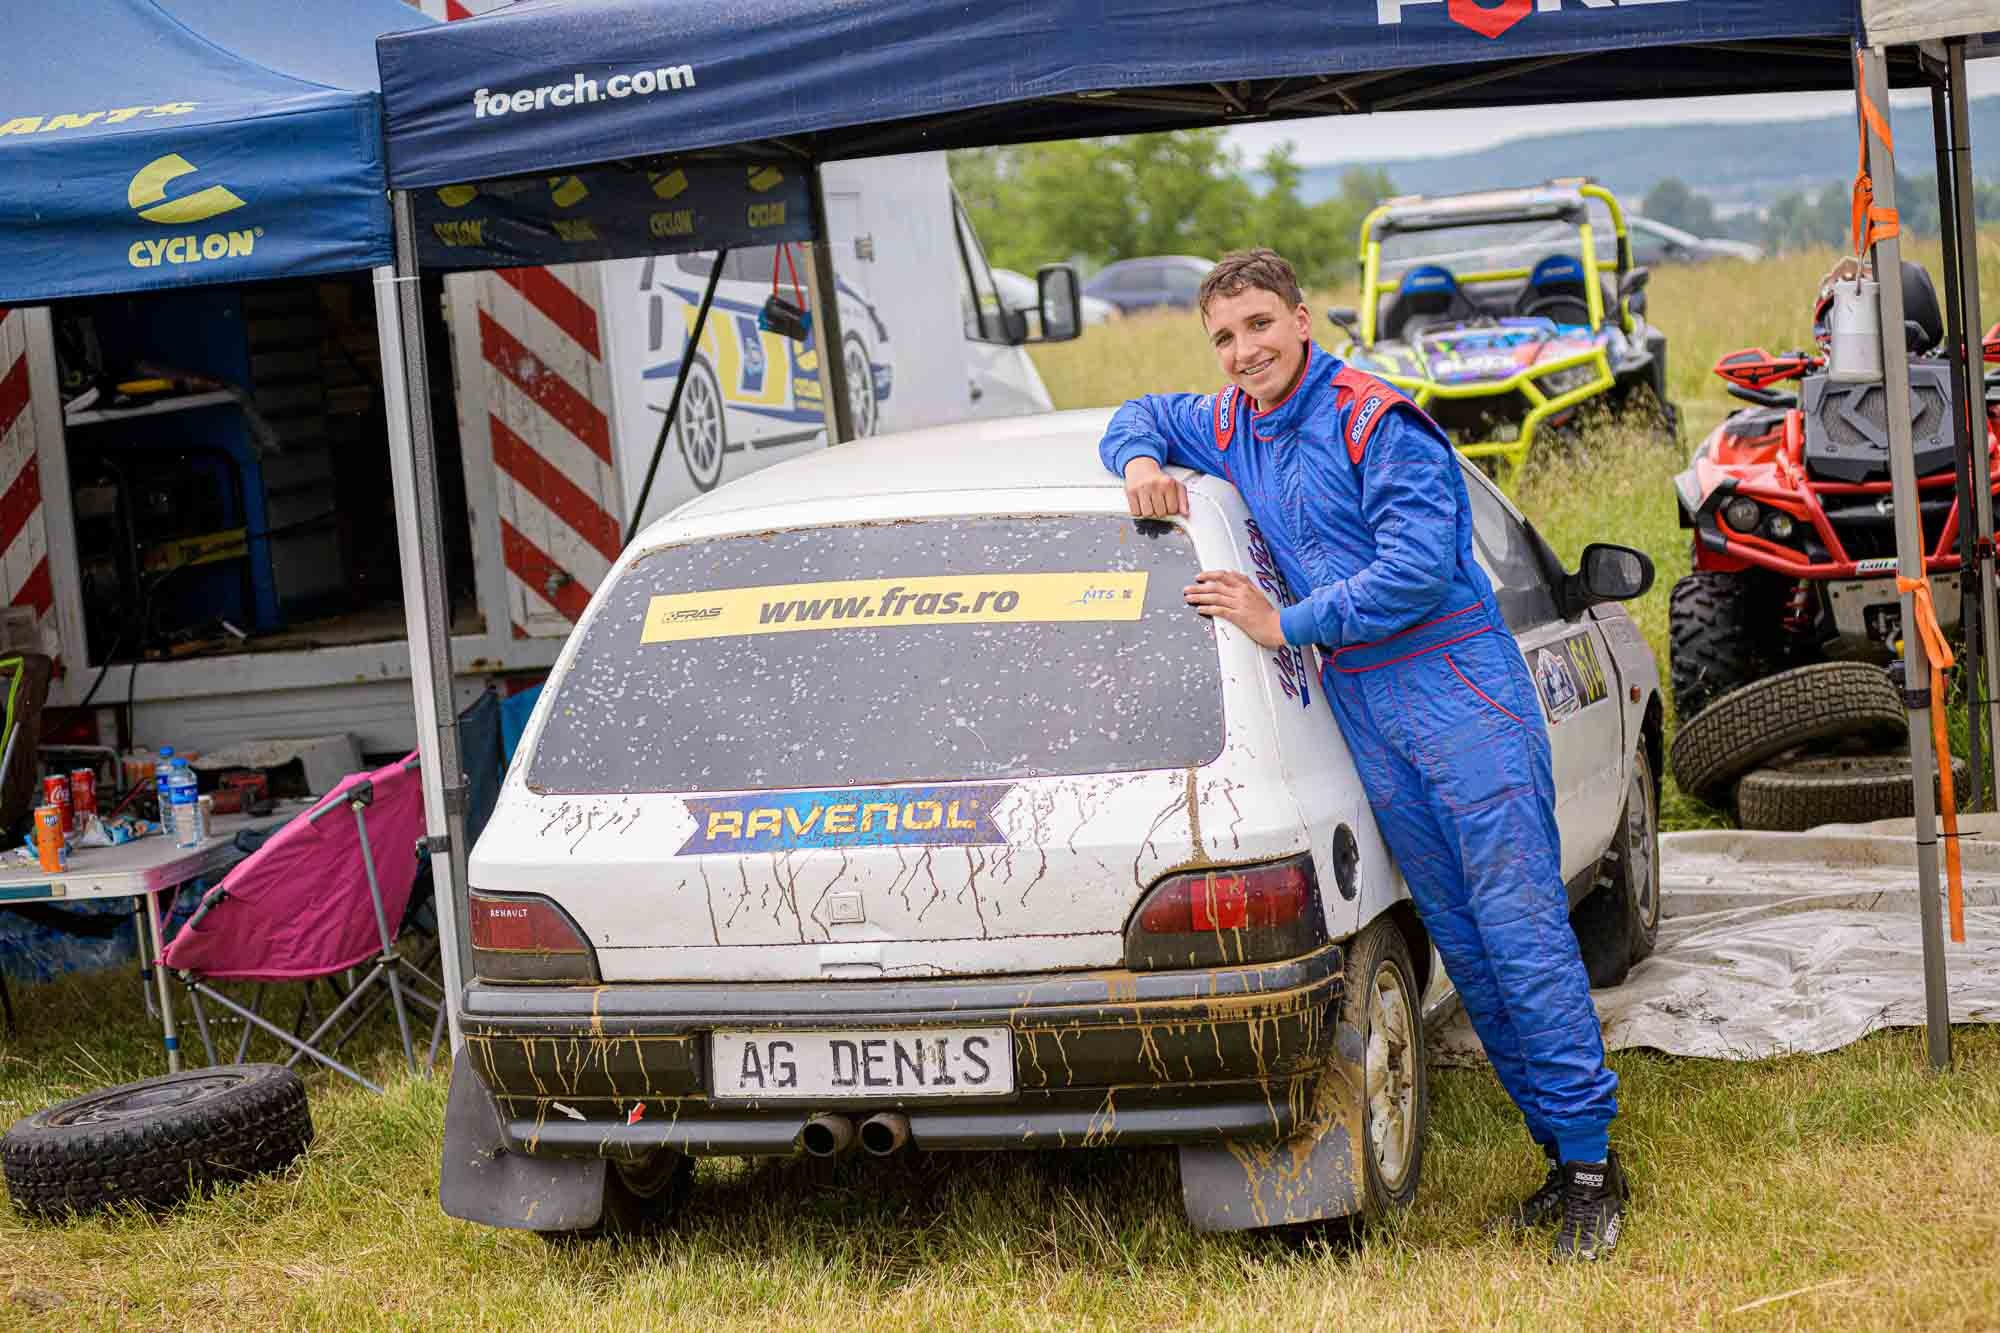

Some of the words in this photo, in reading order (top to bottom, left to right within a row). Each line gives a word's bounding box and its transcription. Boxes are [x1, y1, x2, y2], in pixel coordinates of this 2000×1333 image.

[473, 64, 697, 119] foerch.com
[128, 229, 254, 268] CYCLON
[1352, 398, 1380, 442] sparco
[759, 587, 1020, 626] www.fras.ro
[706, 799, 977, 840] RAVENOL
[490, 909, 529, 918] RENAULT
[739, 1040, 798, 1089] AG
[829, 1036, 990, 1087] DENIS
